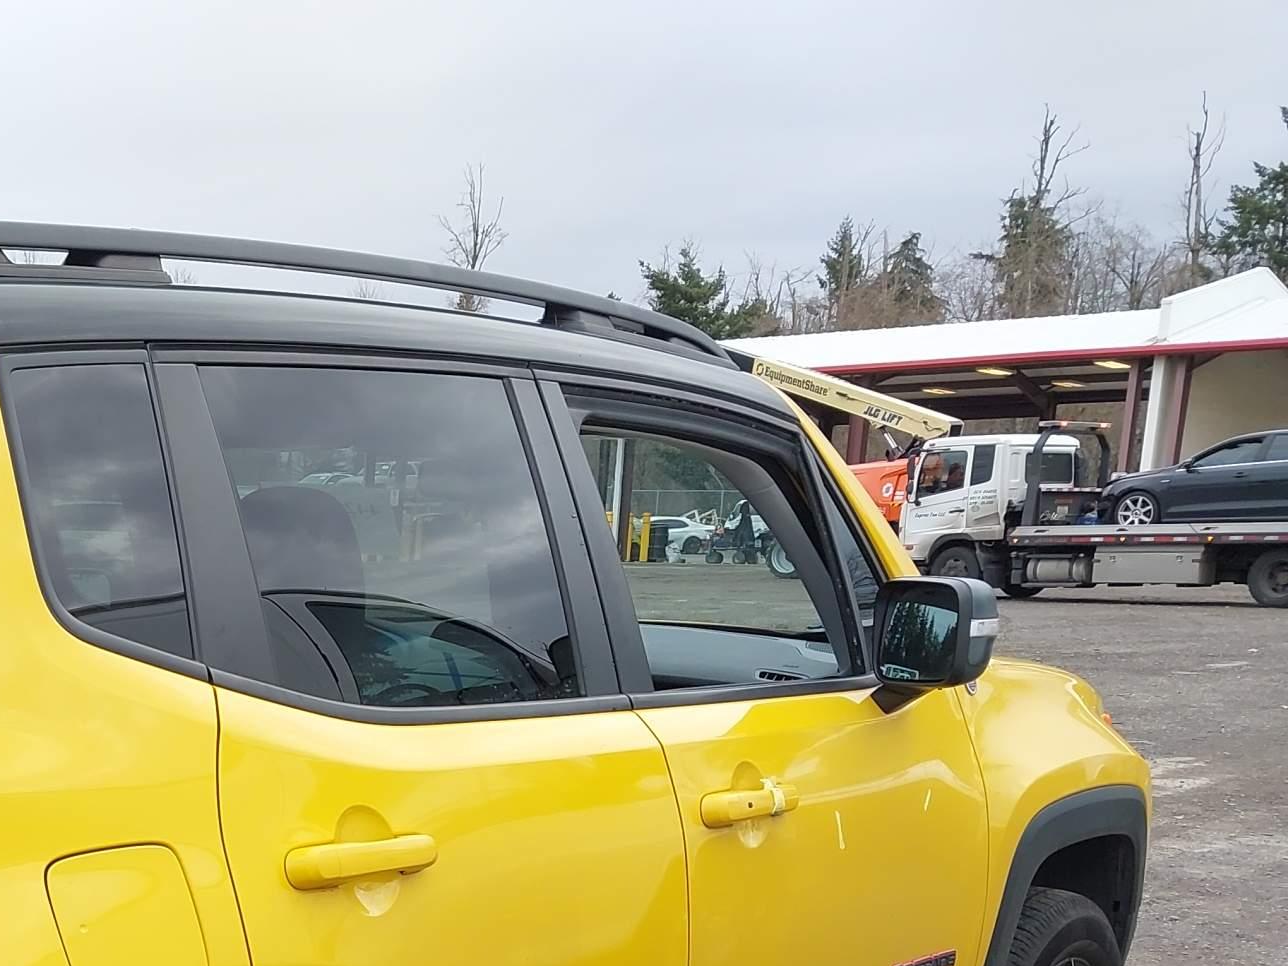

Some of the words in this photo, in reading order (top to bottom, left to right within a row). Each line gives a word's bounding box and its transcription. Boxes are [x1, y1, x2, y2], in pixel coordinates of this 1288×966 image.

[764, 366, 828, 396] EquipmentShare
[863, 405, 880, 418] JLG
[881, 411, 903, 426] LIFT
